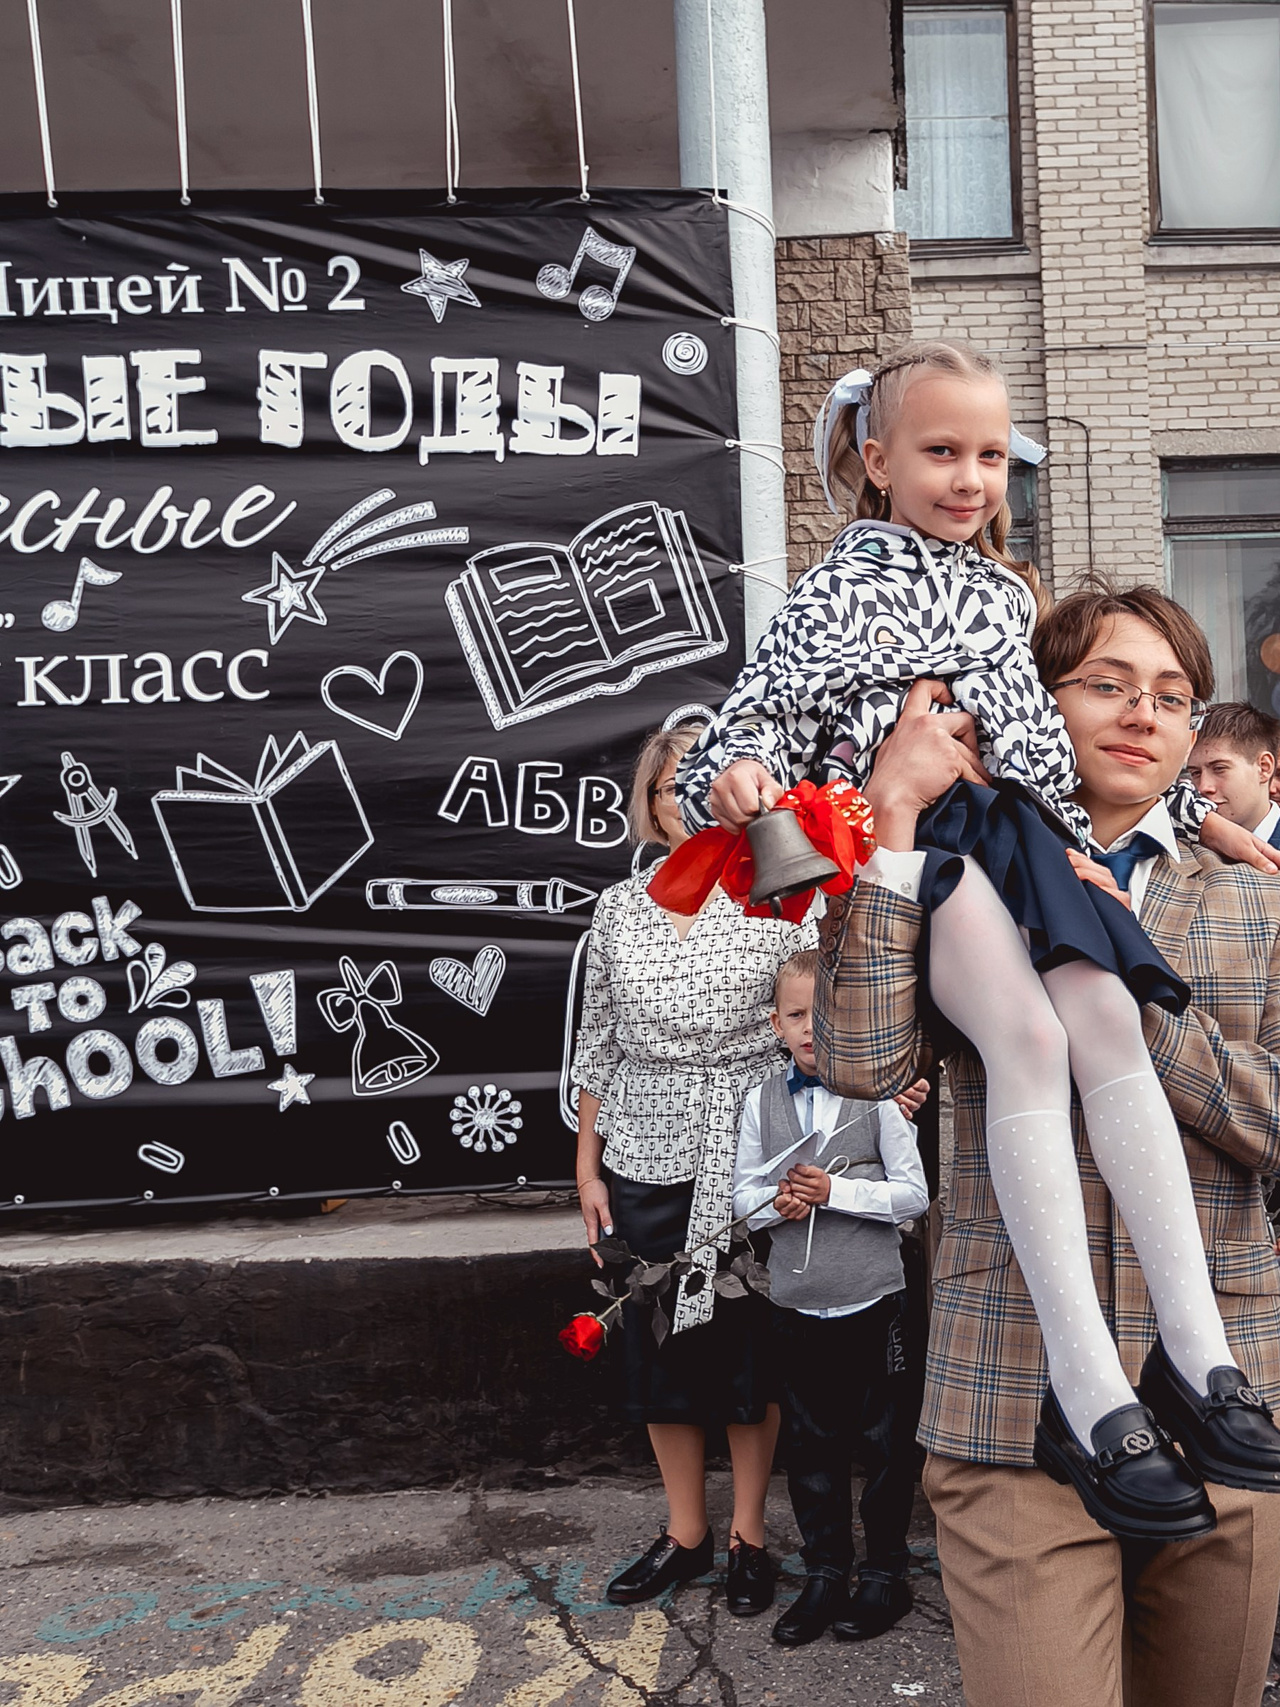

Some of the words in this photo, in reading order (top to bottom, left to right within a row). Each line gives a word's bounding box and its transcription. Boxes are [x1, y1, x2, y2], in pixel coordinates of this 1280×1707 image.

[221, 257, 308, 313] №
[327, 255, 366, 311] 2
[257, 349, 643, 465] ГОДЫ
[0, 485, 297, 553] сные
[15, 648, 270, 707] класс
[438, 756, 628, 848] АБВ
[0, 895, 143, 976] ack
[0, 968, 298, 1121] hOOL!
